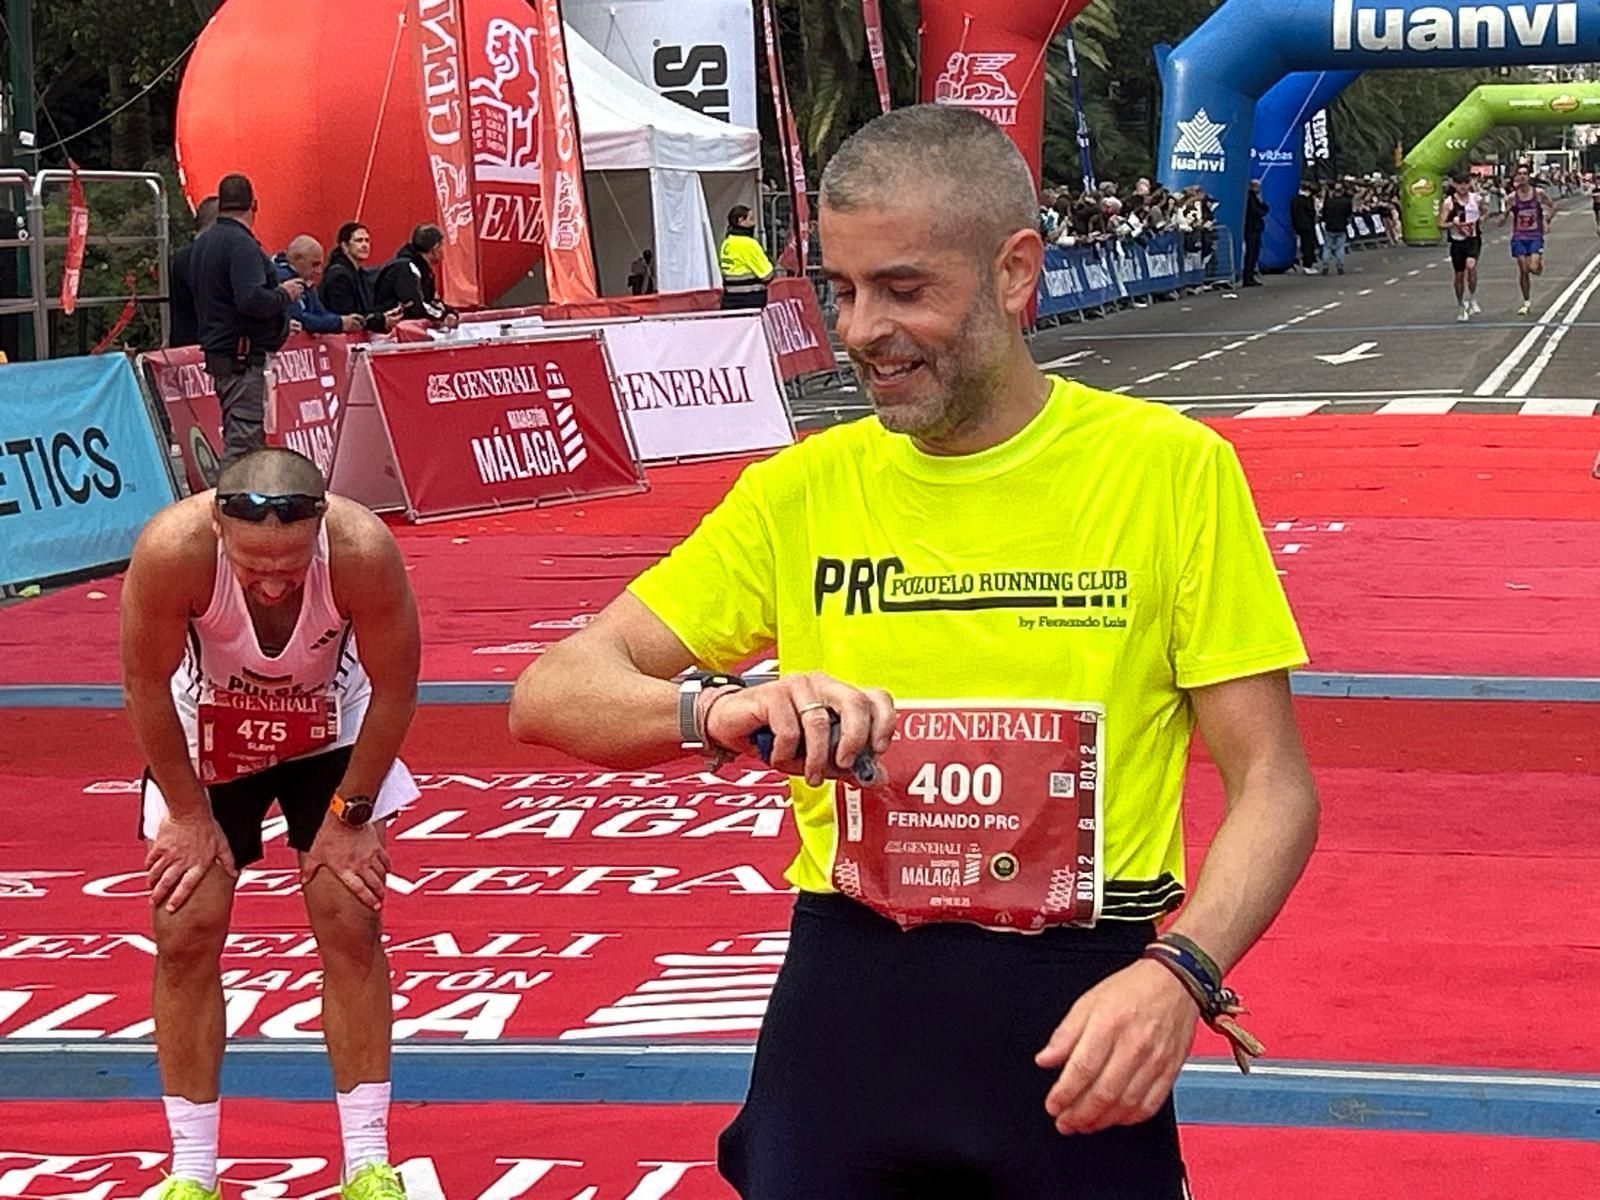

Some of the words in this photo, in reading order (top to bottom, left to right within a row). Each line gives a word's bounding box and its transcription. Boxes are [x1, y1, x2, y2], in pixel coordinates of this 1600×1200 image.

[1333, 0, 1577, 50] luanvi
[1171, 154, 1225, 172] luanvi
[453, 365, 542, 400] GENERALI
[471, 427, 567, 484] MÁLAGA
[890, 574, 975, 596] POZUELO
[979, 571, 1074, 592] RUNNING
[1077, 569, 1128, 590] CLUB
[1018, 617, 1036, 630] by
[1038, 615, 1101, 628] Fernando
[1103, 615, 1127, 628] Luis
[231, 695, 318, 713] GENERALI
[236, 719, 287, 742] 475
[904, 712, 1062, 743] GENERALI
[1079, 744, 1096, 755] 2
[907, 763, 1002, 805] 400
[1079, 760, 1096, 790] BOX
[887, 811, 980, 830] FERNANDO
[984, 811, 1020, 830] PRC
[903, 841, 961, 855] GENERALI
[1077, 855, 1094, 865] 2
[901, 864, 961, 887] MÁLAGA
[1076, 869, 1094, 901] BOX
